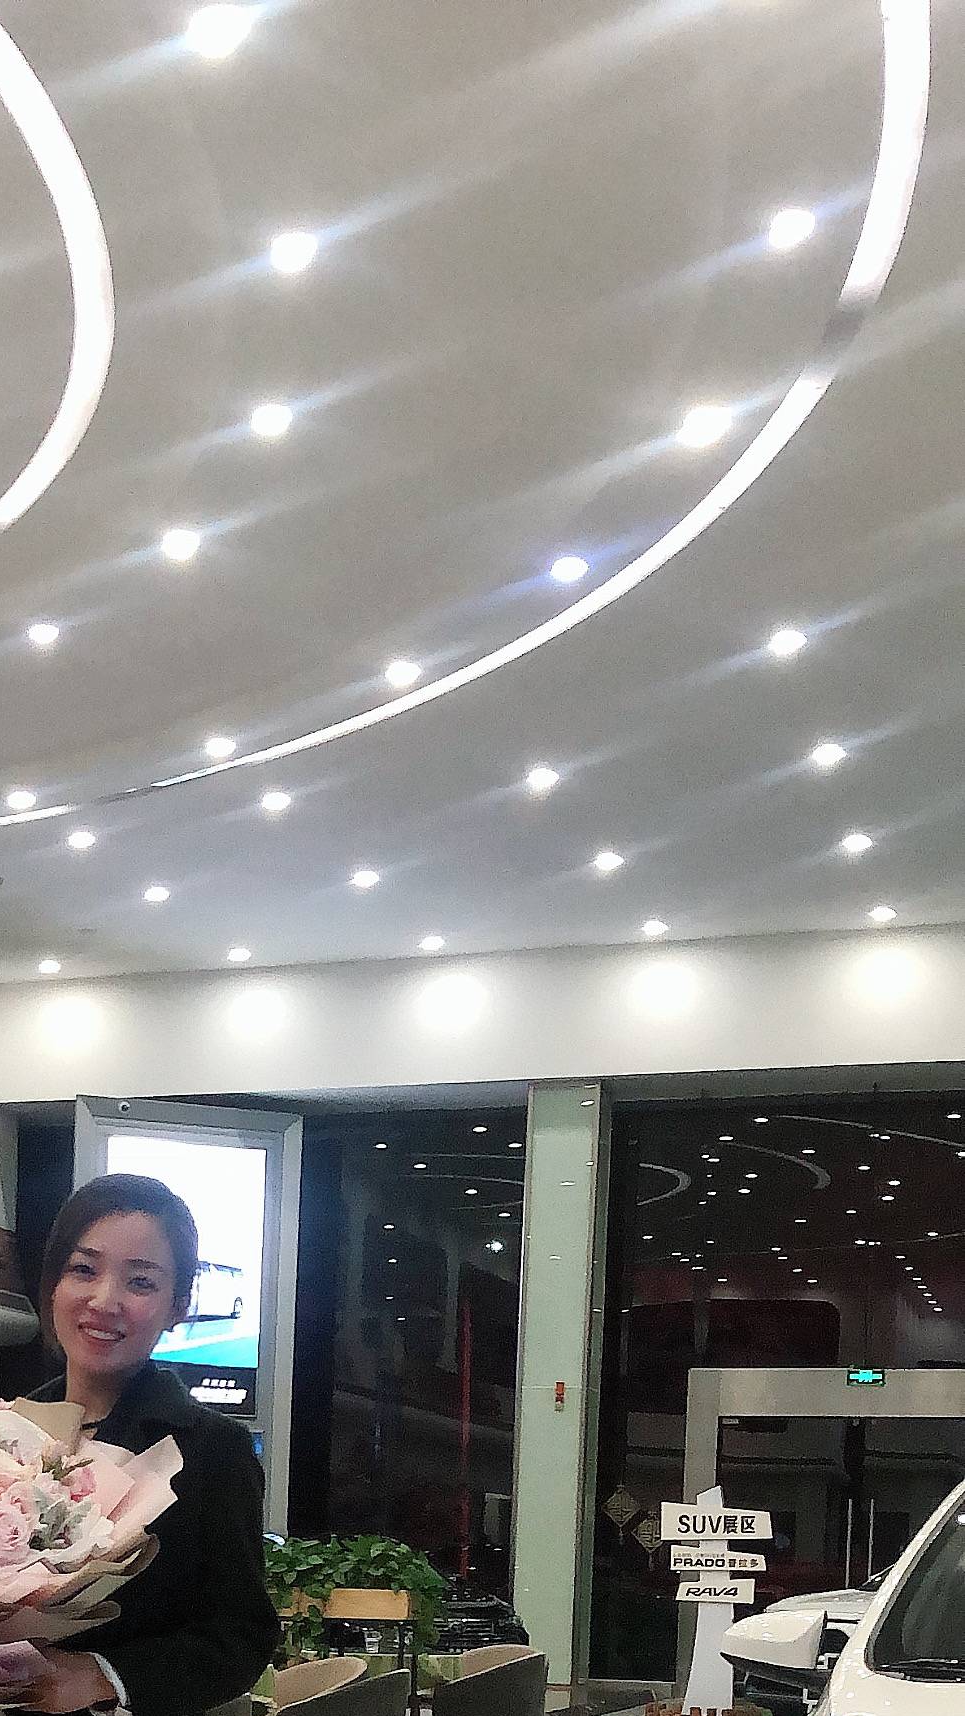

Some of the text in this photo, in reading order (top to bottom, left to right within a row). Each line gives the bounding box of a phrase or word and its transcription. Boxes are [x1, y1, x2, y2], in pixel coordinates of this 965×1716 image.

[677, 1514, 756, 1535] SUV展区
[673, 1557, 726, 1568] PRADO
[686, 1586, 739, 1597] RAV4
